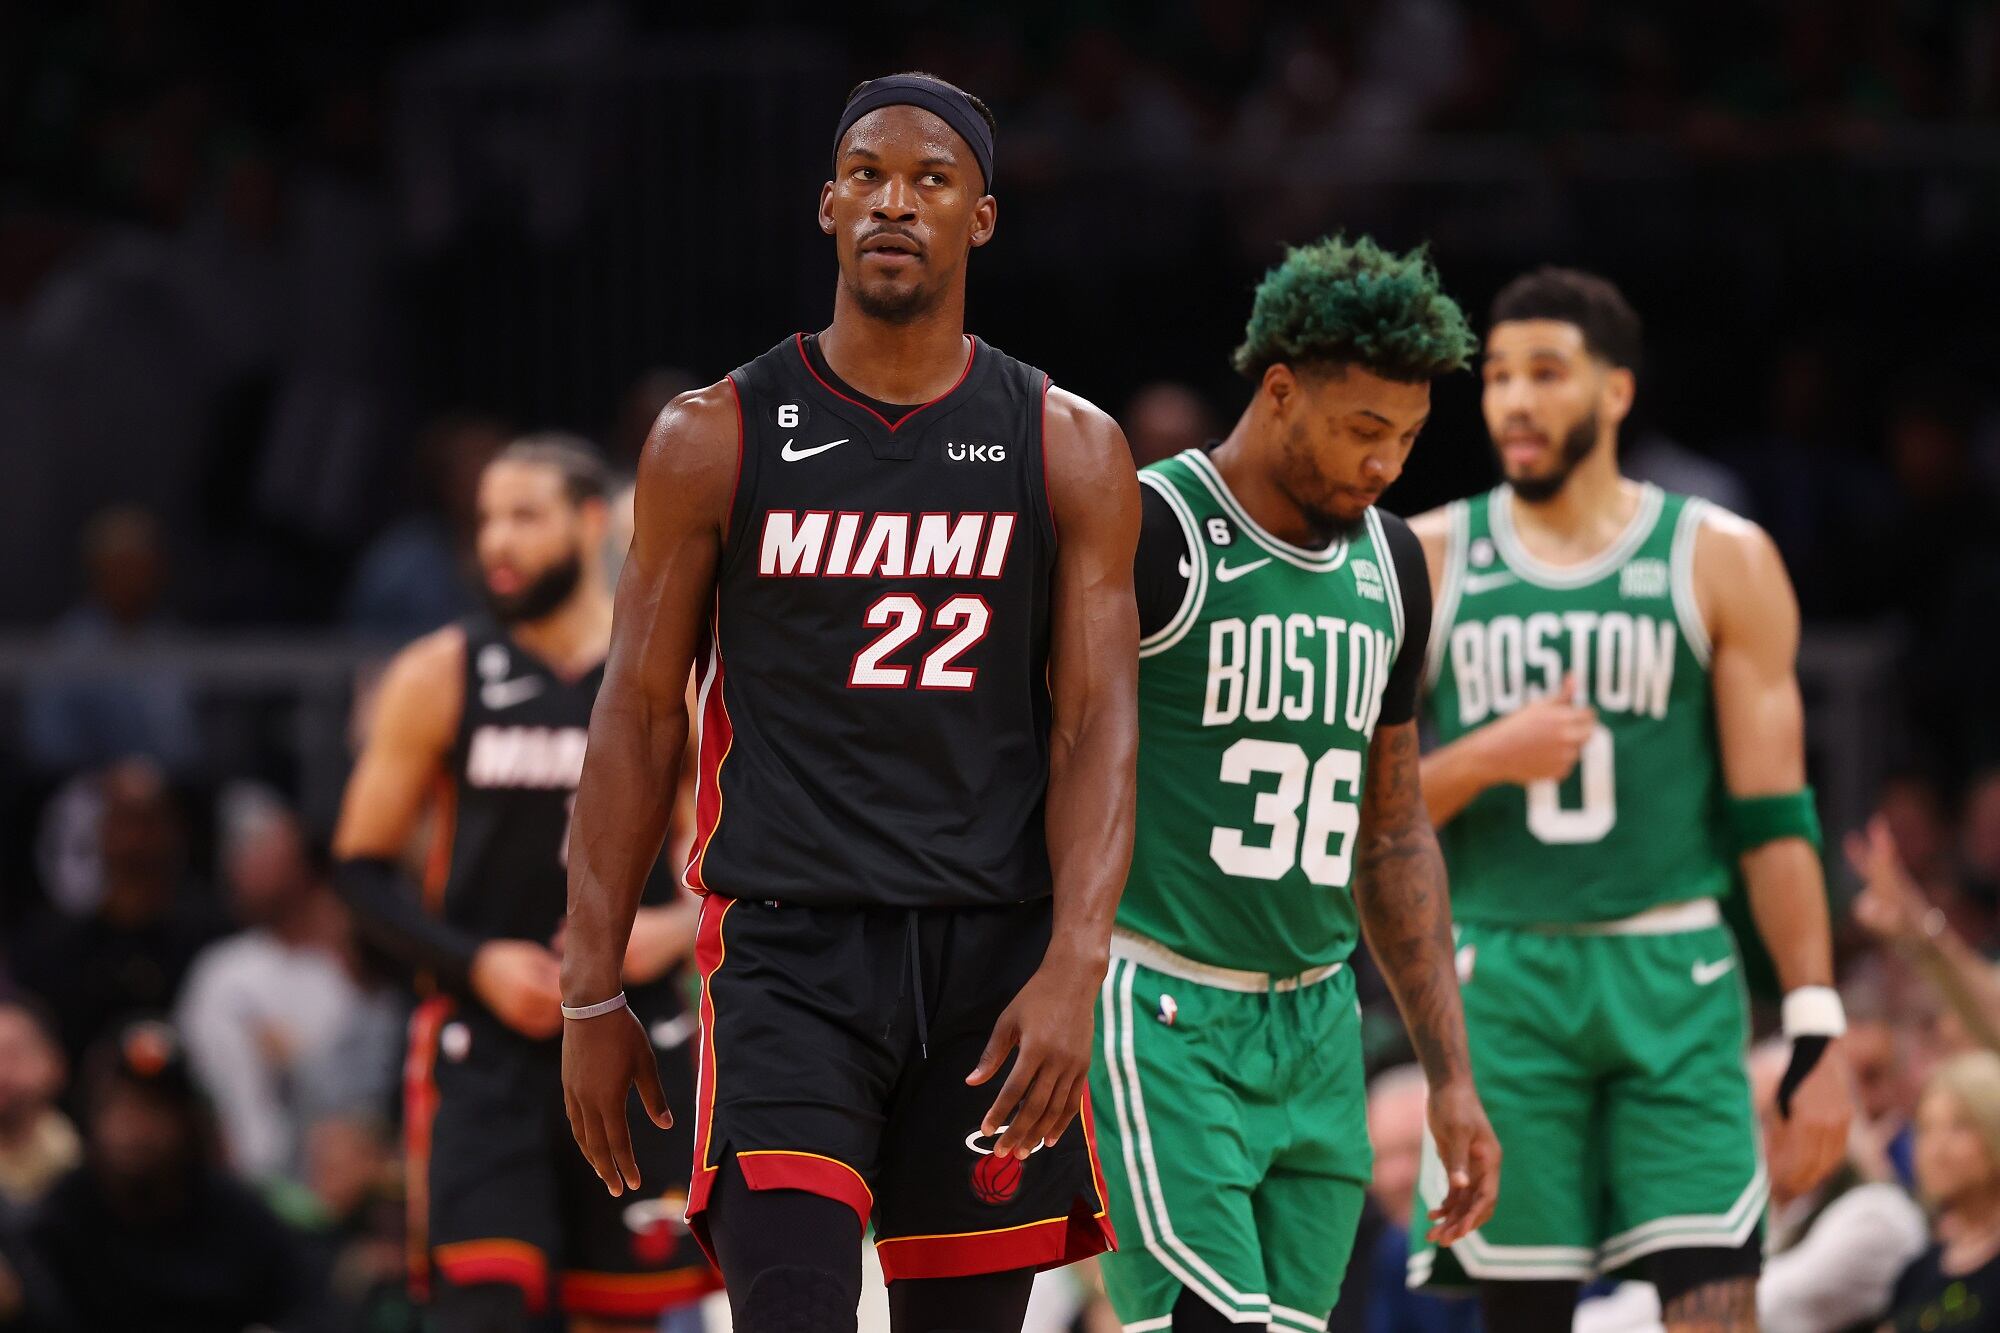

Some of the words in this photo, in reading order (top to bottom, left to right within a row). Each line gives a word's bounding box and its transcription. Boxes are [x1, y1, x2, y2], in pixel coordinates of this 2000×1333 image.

[777, 404, 799, 428] 6
[758, 510, 1018, 580] MIAMI
[1207, 519, 1231, 545] 6
[846, 592, 993, 691] 22
[1202, 613, 1393, 743] BOSTON
[1451, 610, 1675, 727] BOSTON
[1209, 737, 1362, 887] 36
[1526, 722, 1616, 845] 0
